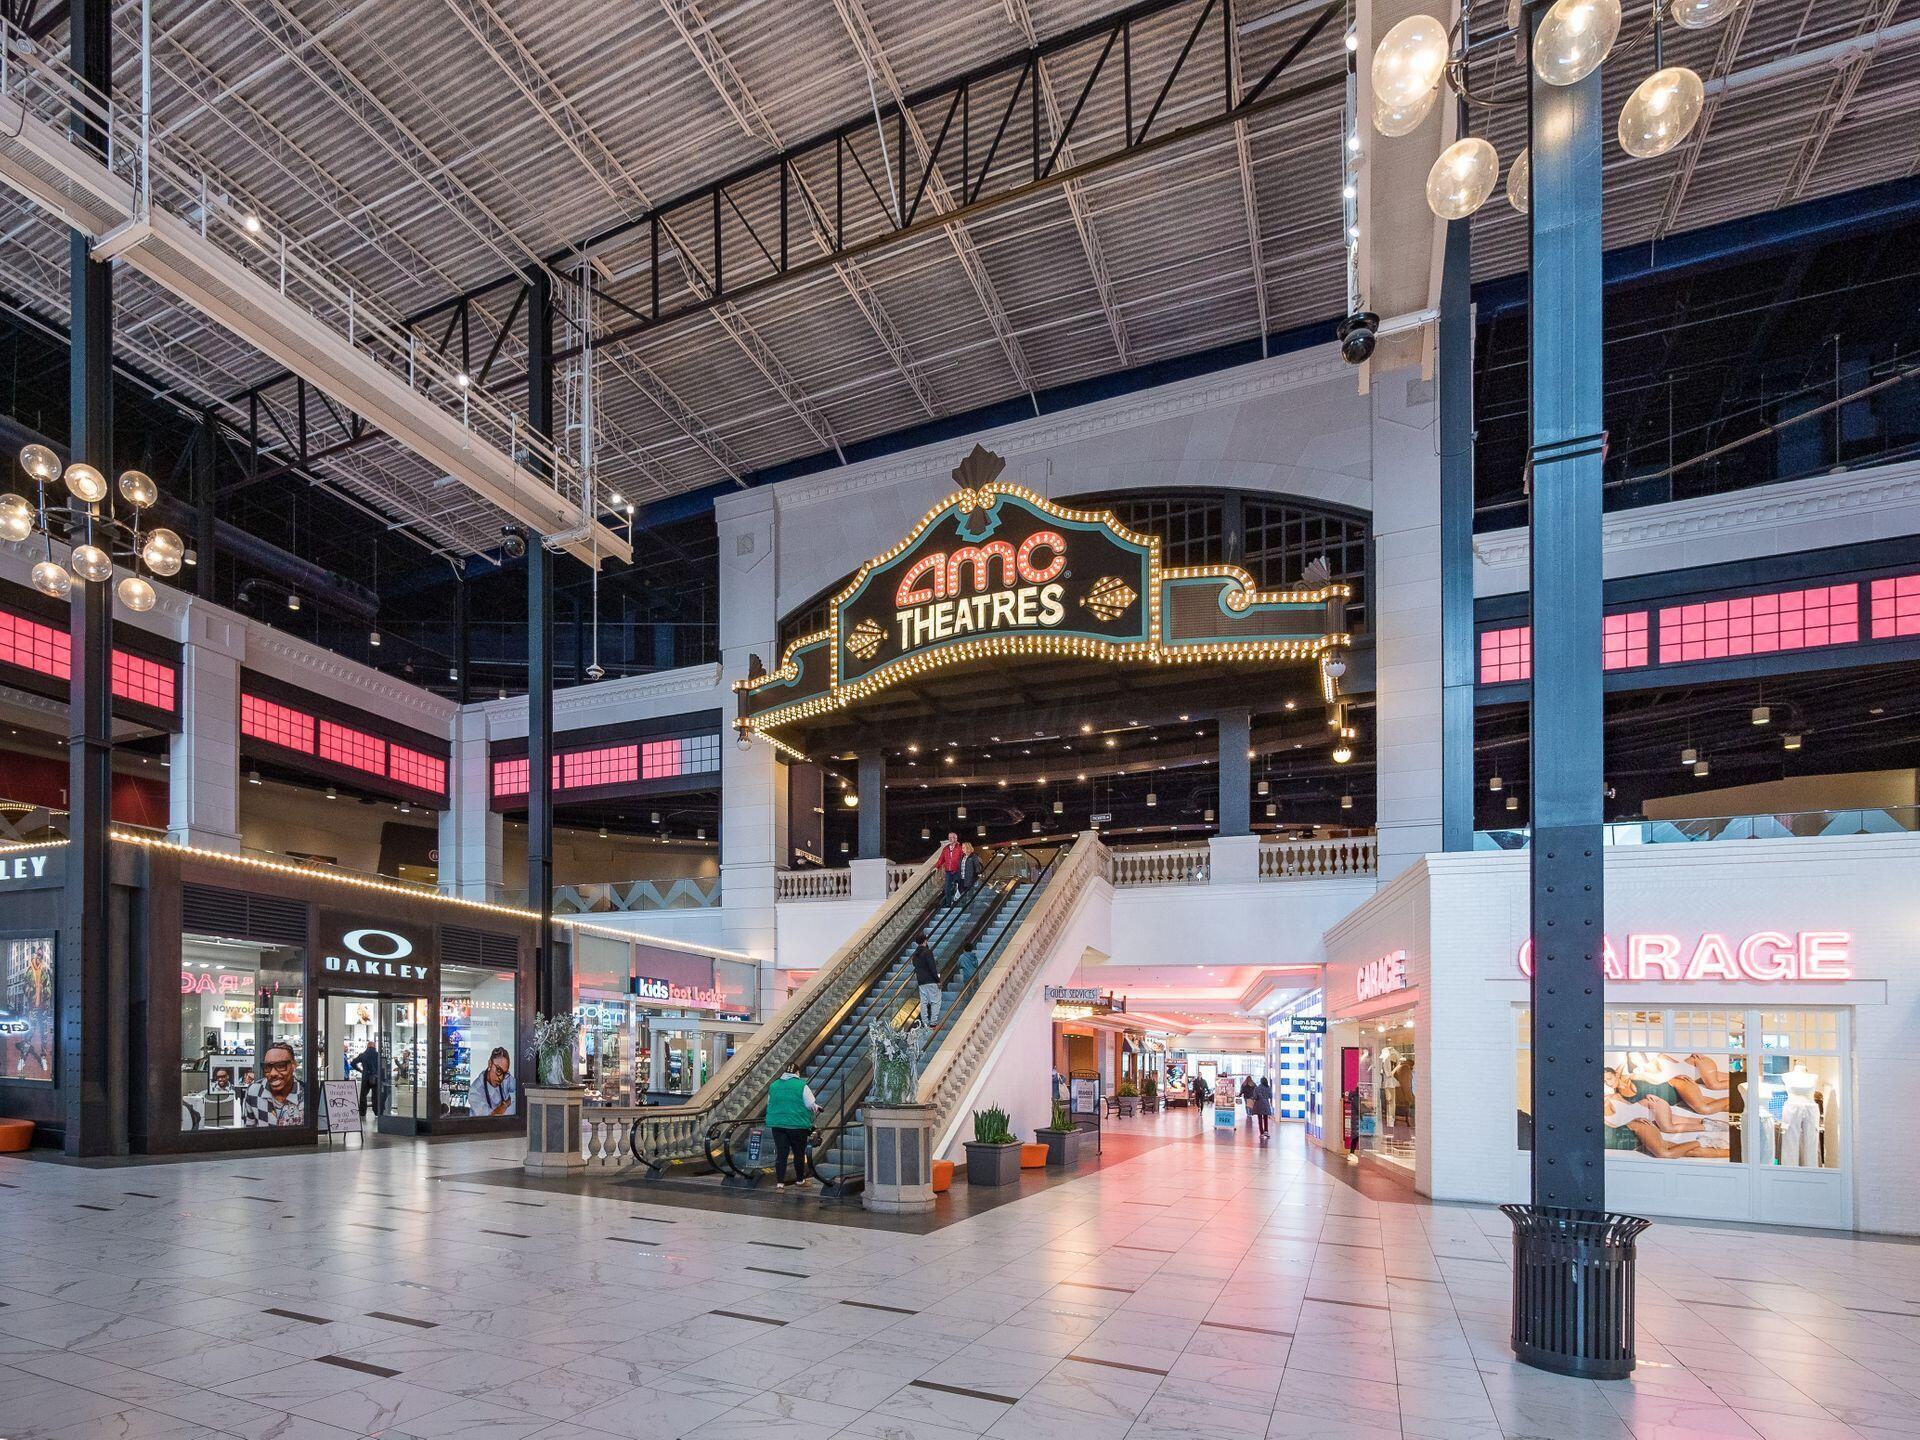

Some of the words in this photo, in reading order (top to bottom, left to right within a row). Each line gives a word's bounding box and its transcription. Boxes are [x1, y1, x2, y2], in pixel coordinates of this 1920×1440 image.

[895, 531, 1067, 608] amc
[896, 583, 1065, 651] THEATRES
[325, 956, 429, 980] OAKLEY
[1517, 931, 1853, 981] RAGE
[640, 978, 669, 999] kids
[669, 983, 692, 999] Foot
[695, 986, 727, 1003] Locker
[1050, 988, 1067, 998] GUEST
[1069, 989, 1095, 999] SERVICES
[1357, 950, 1407, 1002] GARAGE
[213, 1005, 235, 1013] NOW
[236, 1006, 254, 1014] YOU
